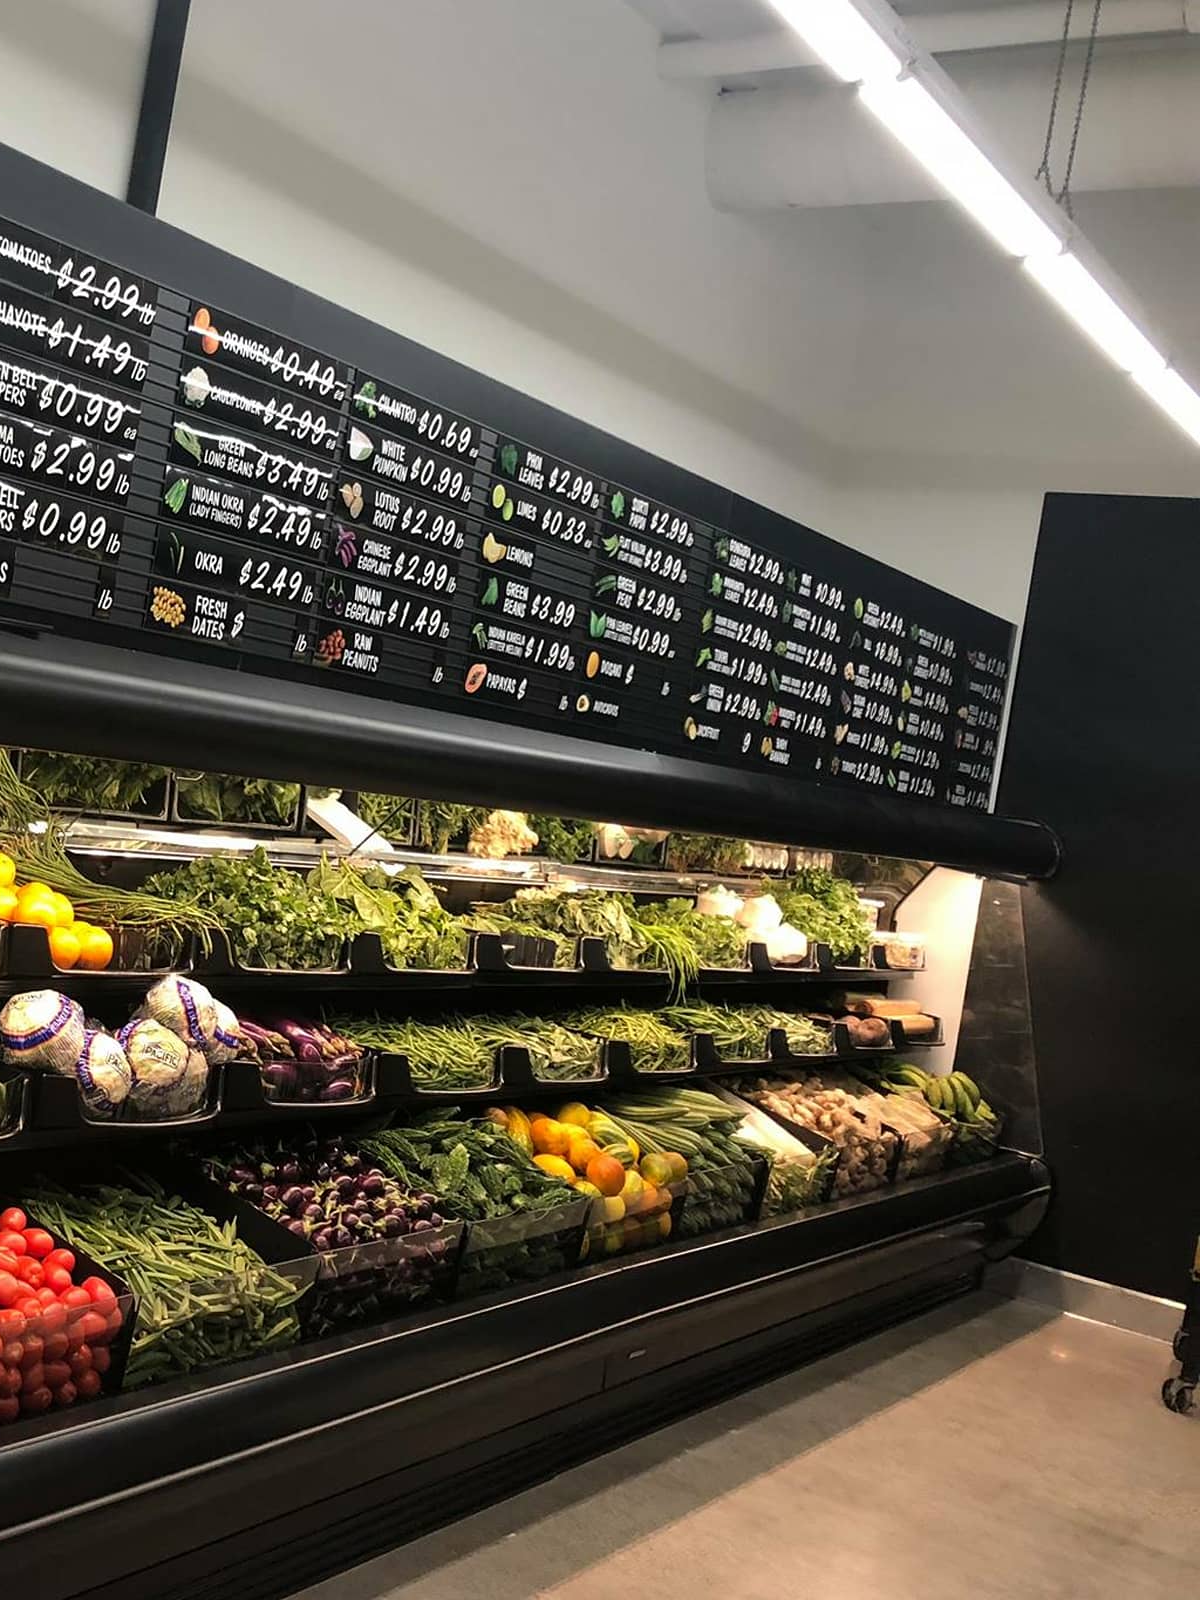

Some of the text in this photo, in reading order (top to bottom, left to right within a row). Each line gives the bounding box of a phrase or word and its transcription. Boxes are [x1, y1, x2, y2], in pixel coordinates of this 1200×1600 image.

[57, 258, 139, 318] $2.99
[139, 305, 156, 325] lb
[48, 318, 131, 374] $1.49
[131, 361, 148, 382] lb
[222, 330, 270, 367] ORANGES
[270, 346, 335, 395] $0.49
[11, 364, 38, 391] BELL
[39, 379, 124, 434] $0.99
[123, 426, 137, 440] ea
[211, 386, 261, 416] CAULIFLOWER
[263, 398, 327, 445] $2.99
[378, 394, 417, 425] CILANTRO
[418, 410, 471, 453] $0.69
[30, 440, 116, 491] $2.99
[115, 475, 130, 496] lb
[204, 450, 255, 478] LONG BEANS
[218, 438, 329, 501] GREEN $3.49 lb
[372, 454, 408, 483] PUMPKIN
[381, 439, 472, 502] WHITE $0.99 lb
[548, 467, 593, 505] $2.99
[21, 499, 107, 550] $0.99
[106, 534, 121, 555] lb
[189, 502, 242, 529] (LADY FINGERS)
[191, 485, 322, 550] INDIAN OKRA $2.49 lb
[372, 509, 397, 532] ROOT
[374, 490, 464, 549] LOTUS $2.99 lb
[650, 510, 688, 544] $2.99
[195, 551, 313, 604] OKRA $2.49 lb
[357, 555, 393, 578] EGGPLANT
[362, 539, 456, 593] CHINESE $2.99 lb
[98, 589, 113, 610] lb
[344, 601, 386, 627] EGGPLANT
[354, 584, 449, 639] INDIAN $1.49 lb
[530, 594, 575, 628] $3.99
[637, 587, 675, 619] $2.99
[192, 617, 225, 641] DATES
[195, 595, 307, 652] FRESH $ lb
[354, 632, 373, 651] RAW
[632, 626, 670, 656] $0.99
[342, 649, 379, 673] PEANUTS
[524, 635, 570, 669] $1.99
[432, 667, 443, 683] lb
